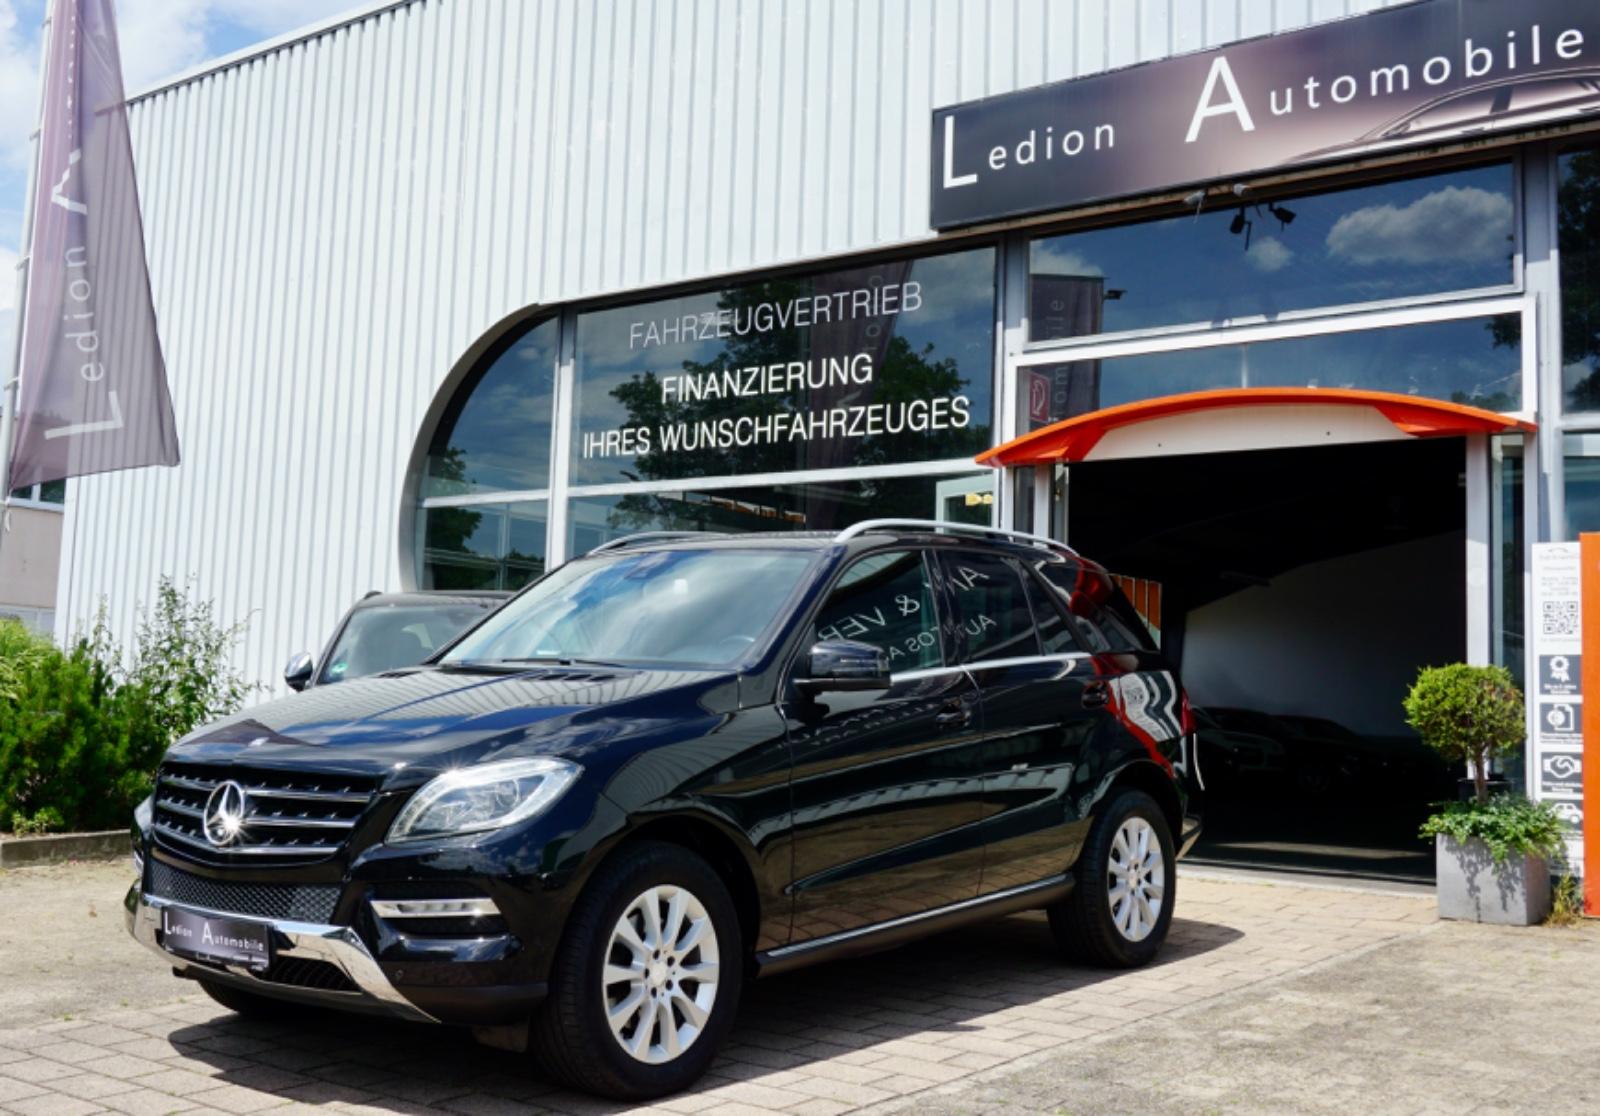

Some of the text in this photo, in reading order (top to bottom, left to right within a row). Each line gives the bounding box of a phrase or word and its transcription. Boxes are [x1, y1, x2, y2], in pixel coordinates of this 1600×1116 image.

[941, 24, 1585, 189] Ledion Automobile
[44, 244, 125, 441] Ledion
[629, 281, 924, 350] FAHRZEUGVERTRIEB
[661, 353, 874, 404] FINANZIERUNG
[582, 395, 971, 460] IHRES WUNSCHFAHRZEUGES
